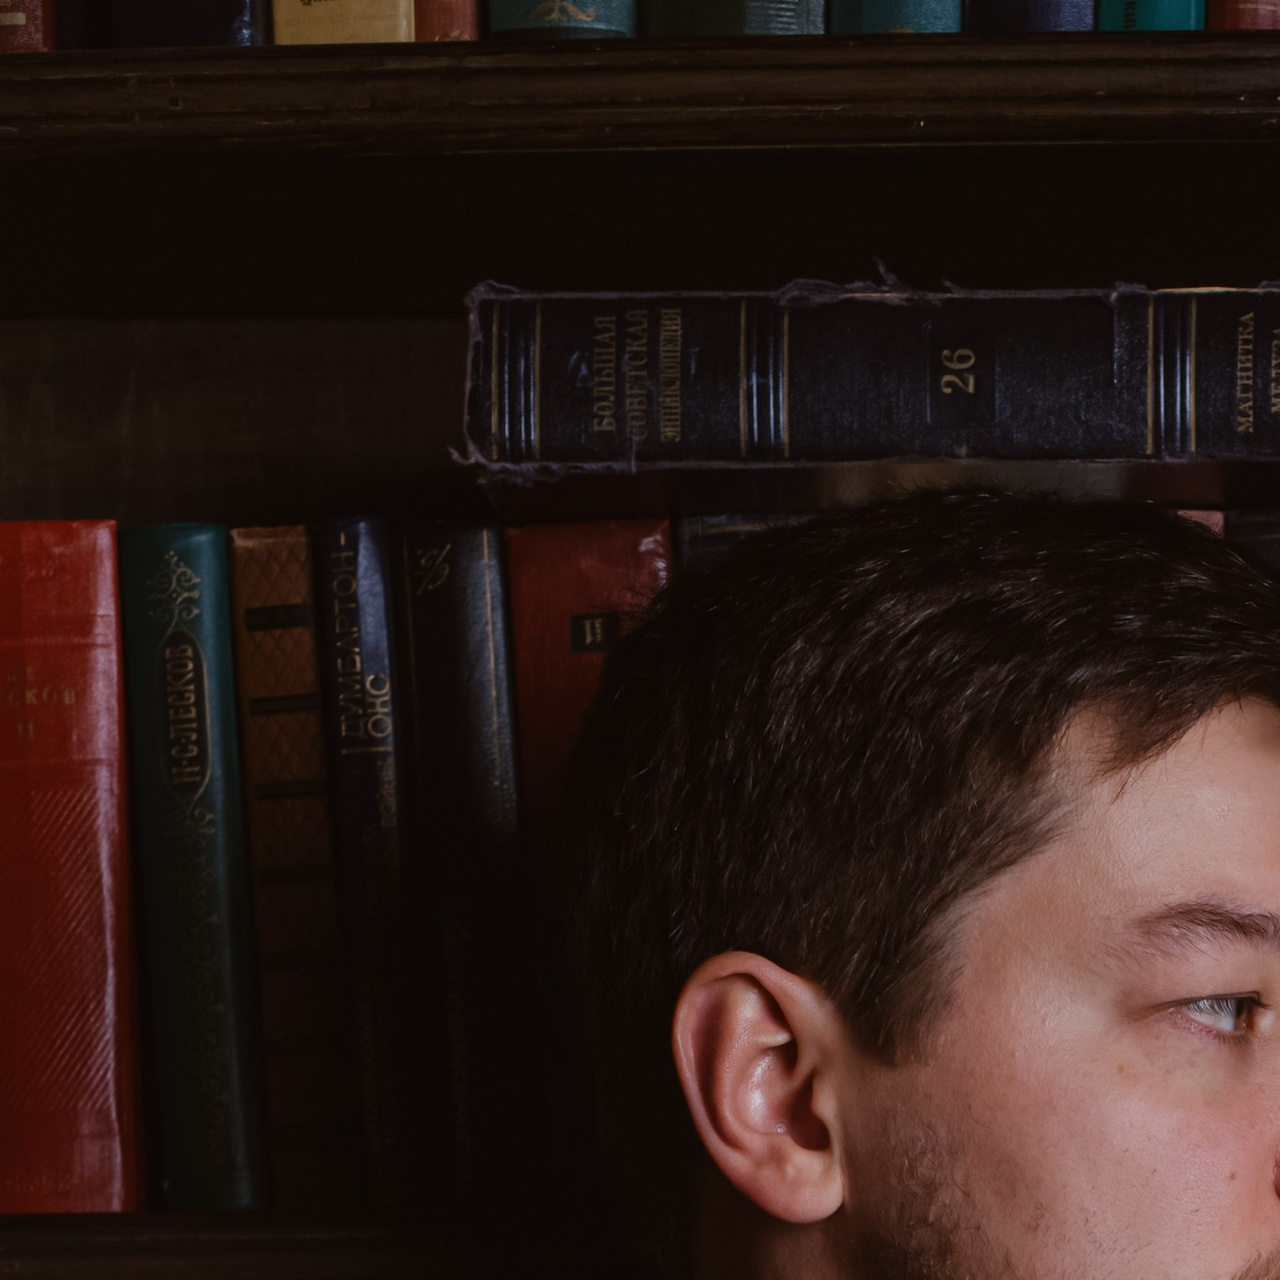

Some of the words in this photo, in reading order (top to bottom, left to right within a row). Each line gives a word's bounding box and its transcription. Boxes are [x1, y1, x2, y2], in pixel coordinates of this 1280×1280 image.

[593, 315, 617, 432] БОЛЬШАЯ
[625, 309, 648, 441] СОВЕТСКАЯ
[660, 308, 682, 443] ЭНЦИКЛОПЕДИЯ
[940, 347, 976, 395] 26
[1236, 311, 1255, 433] МАГНИТКА
[331, 531, 367, 739] ДУМБАРТОН-
[365, 673, 392, 739] ОКС
